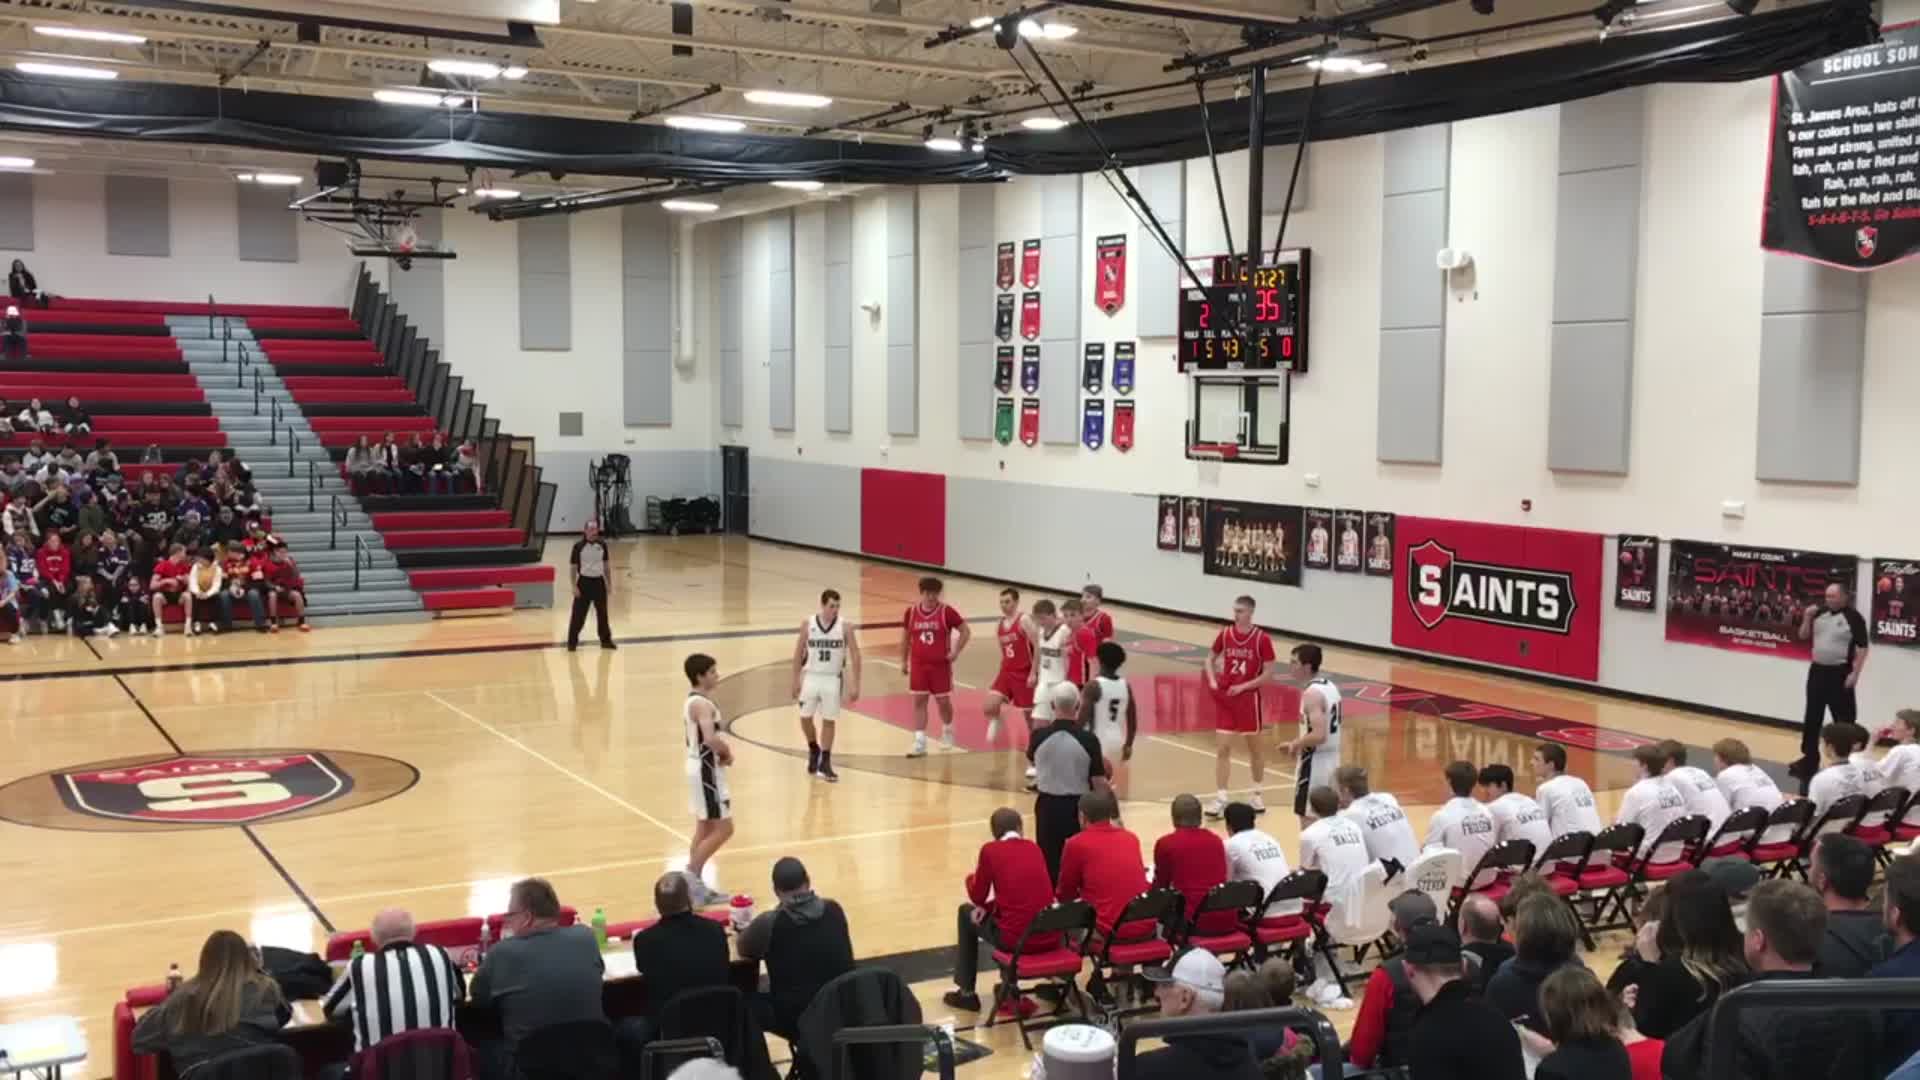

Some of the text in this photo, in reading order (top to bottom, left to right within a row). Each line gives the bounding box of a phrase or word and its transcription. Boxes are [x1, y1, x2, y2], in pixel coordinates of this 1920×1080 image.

[1823, 51, 1881, 74] SCHOOL
[1791, 97, 1917, 124] St. James Area, hats off
[1798, 130, 1815, 141] our
[1817, 126, 1850, 139] colors
[1852, 122, 1874, 134] true
[1876, 121, 1893, 132] we
[1792, 146, 1815, 159] Firm
[1817, 143, 1837, 156] and
[1839, 140, 1875, 154] strong,
[1877, 134, 1912, 149] united
[1814, 160, 1835, 174] rah,
[1837, 159, 1854, 171] rah
[1856, 157, 1872, 169] for
[1874, 154, 1896, 168] Red
[1898, 151, 1918, 165] and
[1823, 170, 1916, 190] Rah, rah, rah, rah.
[1823, 195, 1837, 207] for
[1840, 194, 1857, 206] the
[1859, 191, 1880, 205] Red
[1882, 189, 1903, 203] and
[1905, 187, 1920, 201] Bla
[1256, 289, 1280, 321] 35
[1222, 338, 1239, 358] 43
[1281, 335, 1293, 358] 0
[1731, 551, 1752, 560] MAKE
[1695, 557, 1825, 597] SAINTS
[1419, 564, 1560, 622] SAINTS
[1620, 587, 1652, 603] SAINTS
[919, 631, 934, 646] 43
[1719, 624, 1792, 643] BASKETBALL
[1877, 620, 1917, 638] SAINTS
[1231, 659, 1247, 676] 24
[1108, 698, 1120, 723] 5
[98, 758, 287, 780] SAINTS
[138, 770, 292, 812] S
